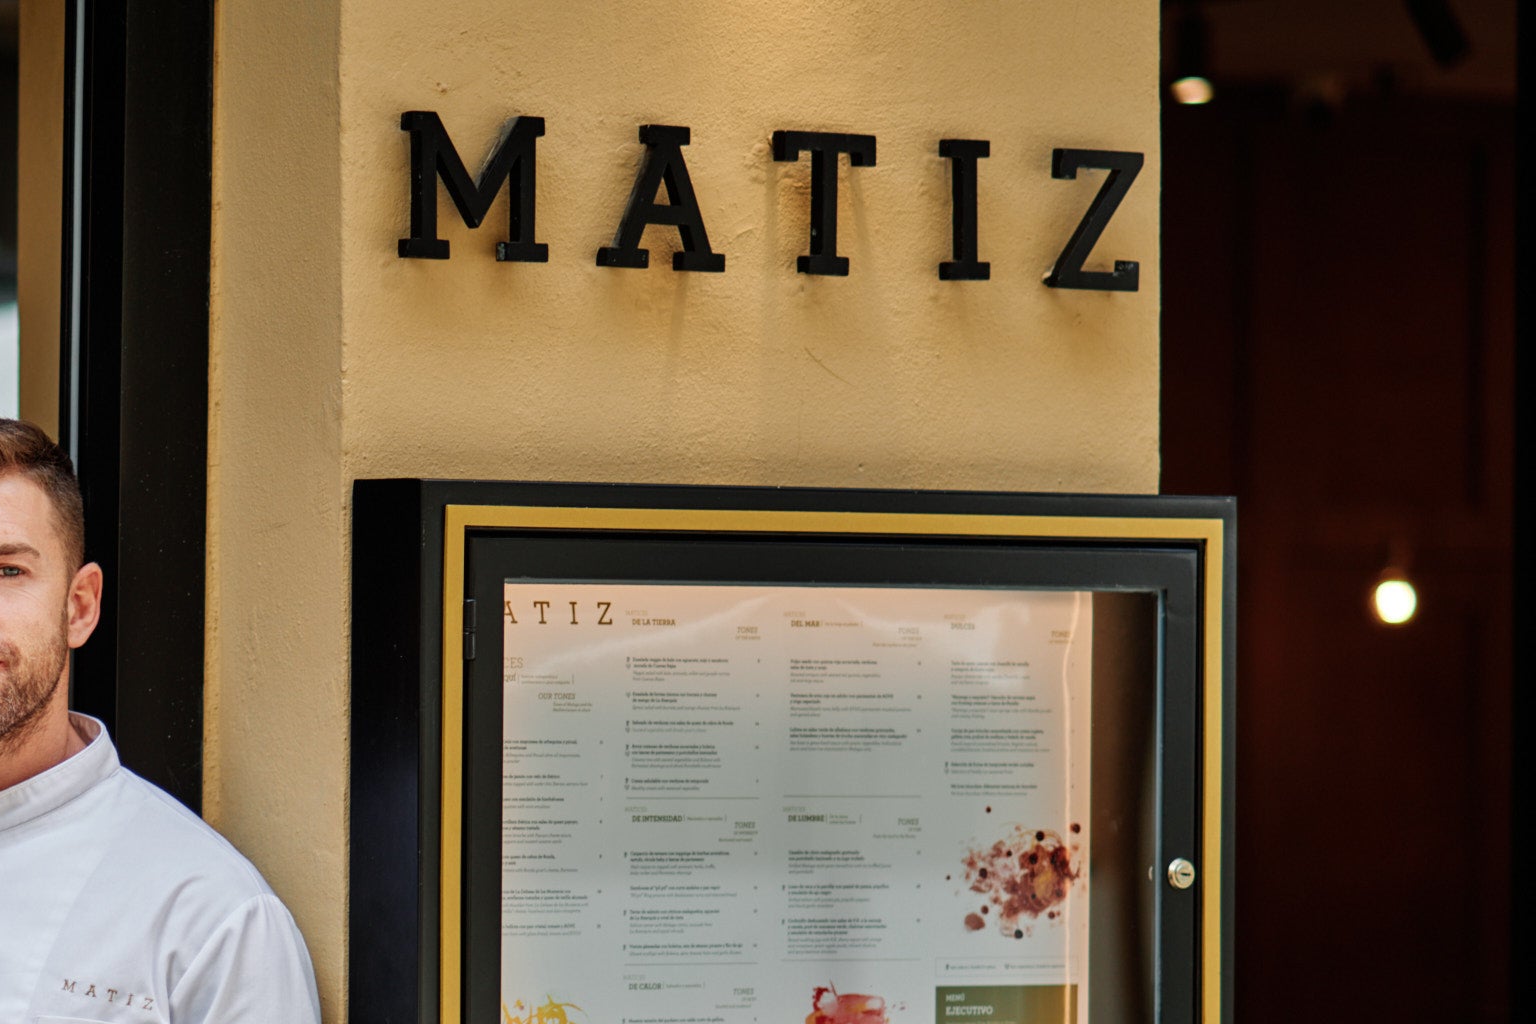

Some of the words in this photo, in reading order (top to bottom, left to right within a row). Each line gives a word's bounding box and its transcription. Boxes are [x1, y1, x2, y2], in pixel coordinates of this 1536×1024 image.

[398, 110, 1145, 292] MATIZ
[632, 618, 641, 626] DE
[642, 618, 651, 626] LA
[652, 618, 676, 627] TIERRA
[790, 620, 804, 628] DEL
[805, 620, 820, 628] MAR
[632, 815, 641, 823] DE
[642, 815, 683, 823] INTENSIDAD
[788, 814, 797, 822] DE
[797, 814, 825, 822] LUMBRE
[628, 983, 638, 991] DE
[639, 982, 662, 990] CALOR
[62, 979, 154, 1011] MATIZ
[945, 993, 965, 1002] MENÚ
[945, 1005, 994, 1016] EJECUTIVO
